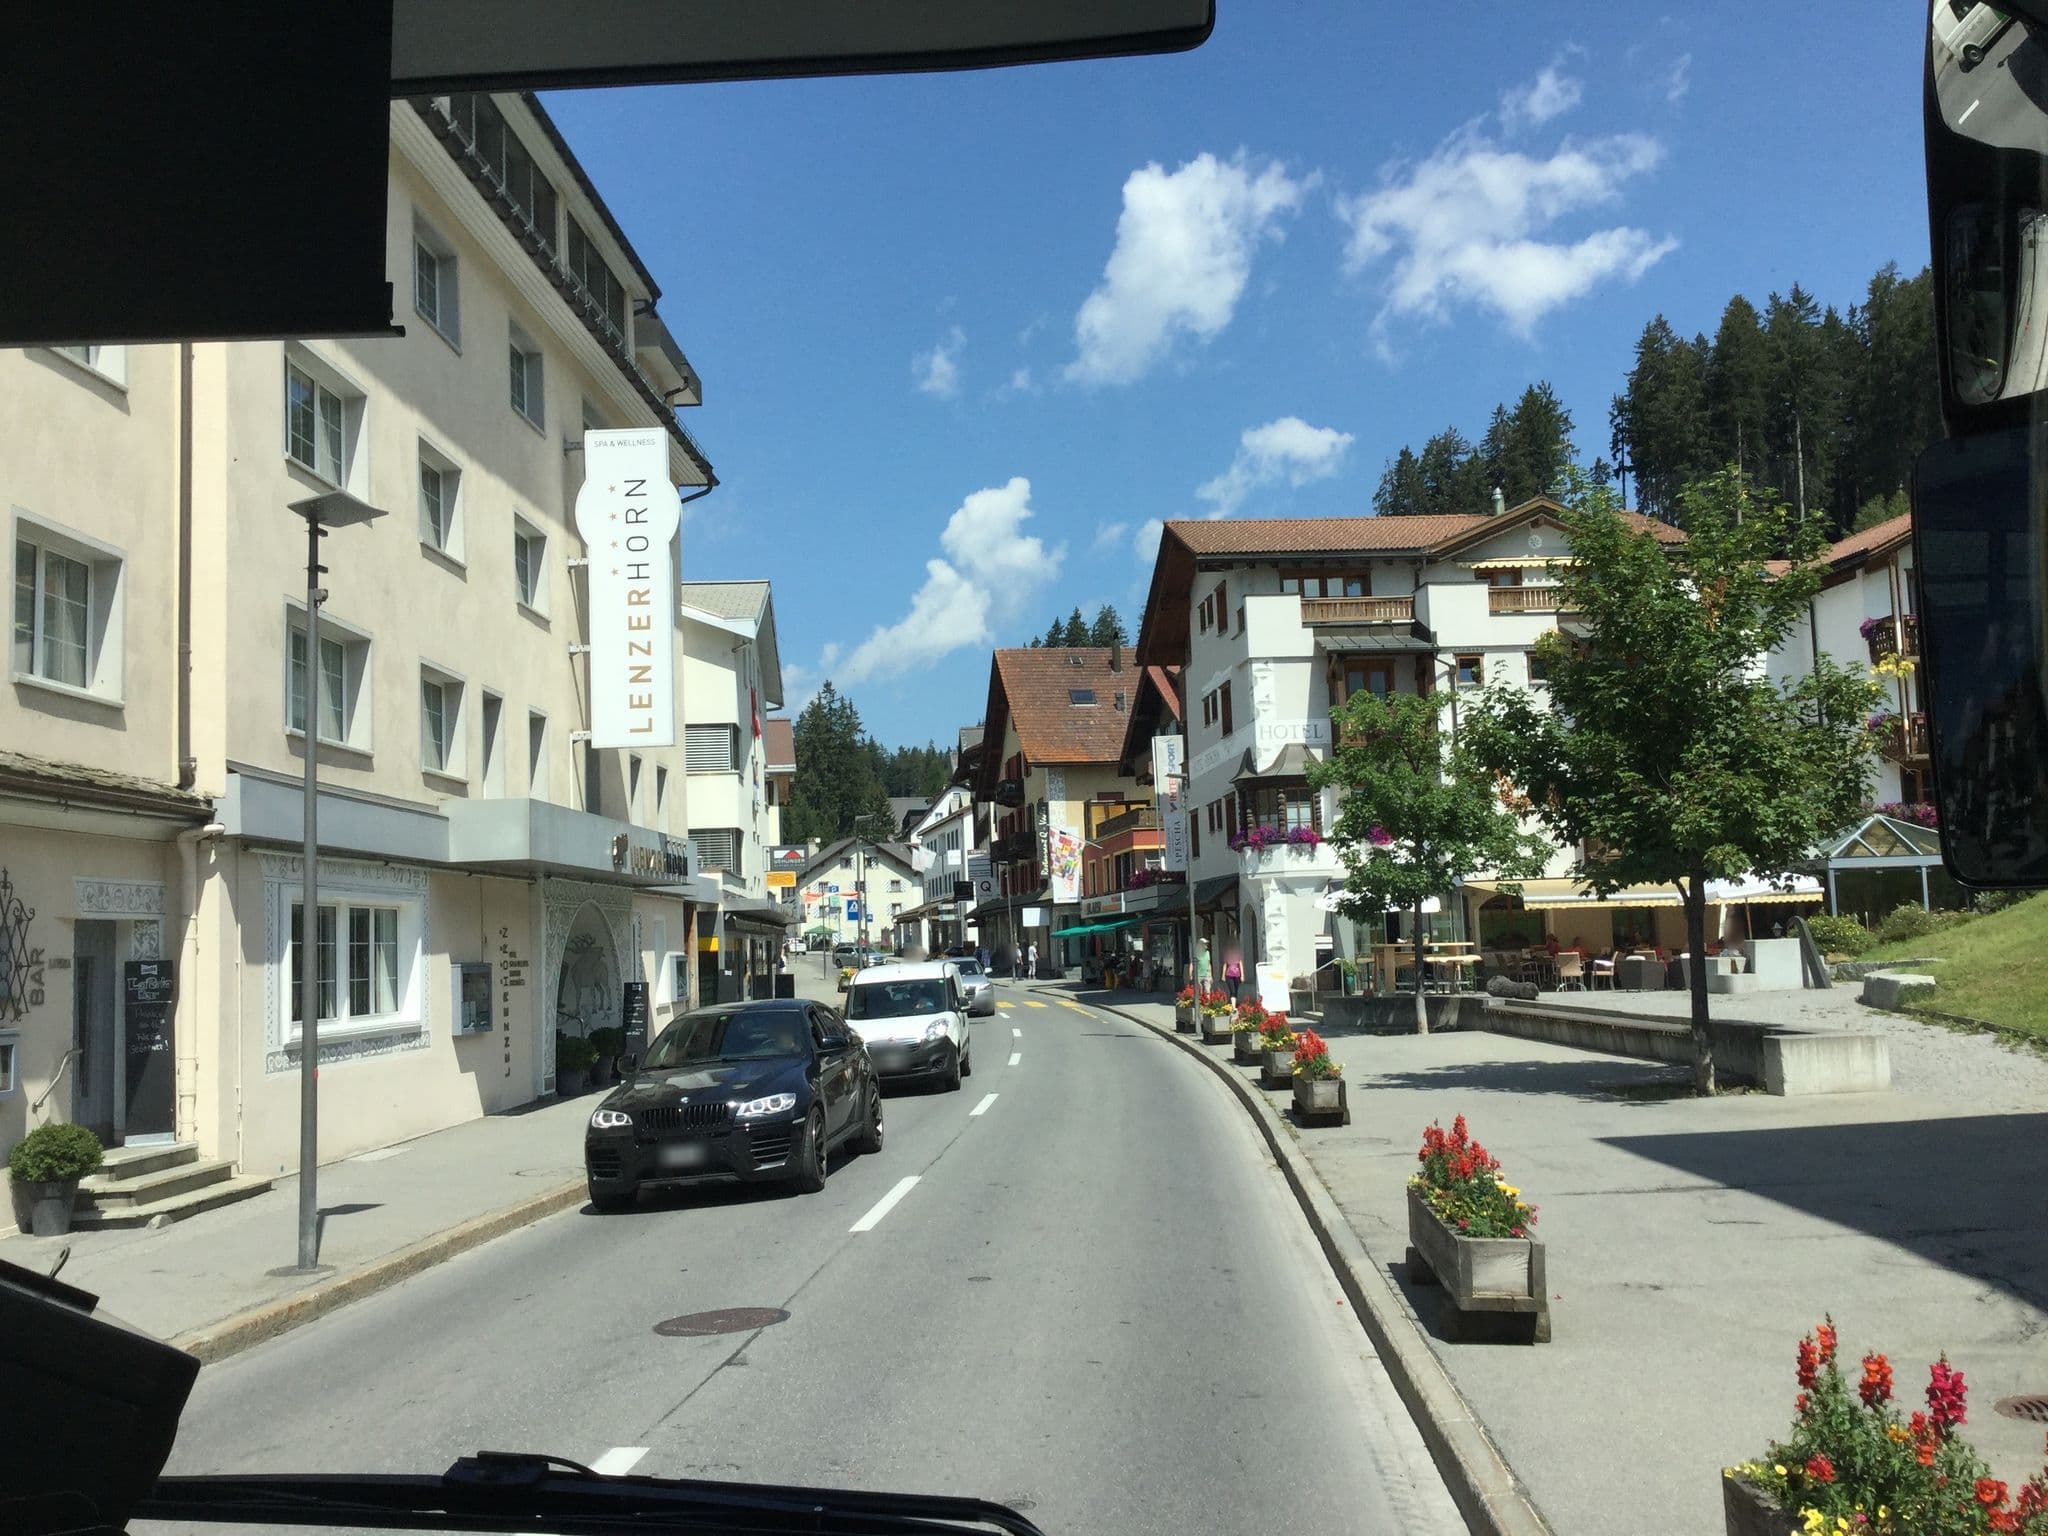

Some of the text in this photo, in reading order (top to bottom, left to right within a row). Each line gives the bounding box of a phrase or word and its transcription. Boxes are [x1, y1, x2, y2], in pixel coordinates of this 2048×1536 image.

[593, 440, 608, 448] SPA
[616, 438, 656, 447] WELLNESS
[623, 478, 653, 734] LENZERHORN
[1260, 724, 1323, 740] HOTEL
[1167, 743, 1178, 802] INTESPORT
[1174, 821, 1183, 864] SPESCHA
[980, 880, 992, 893] Q
[30, 948, 46, 1006] BAR
